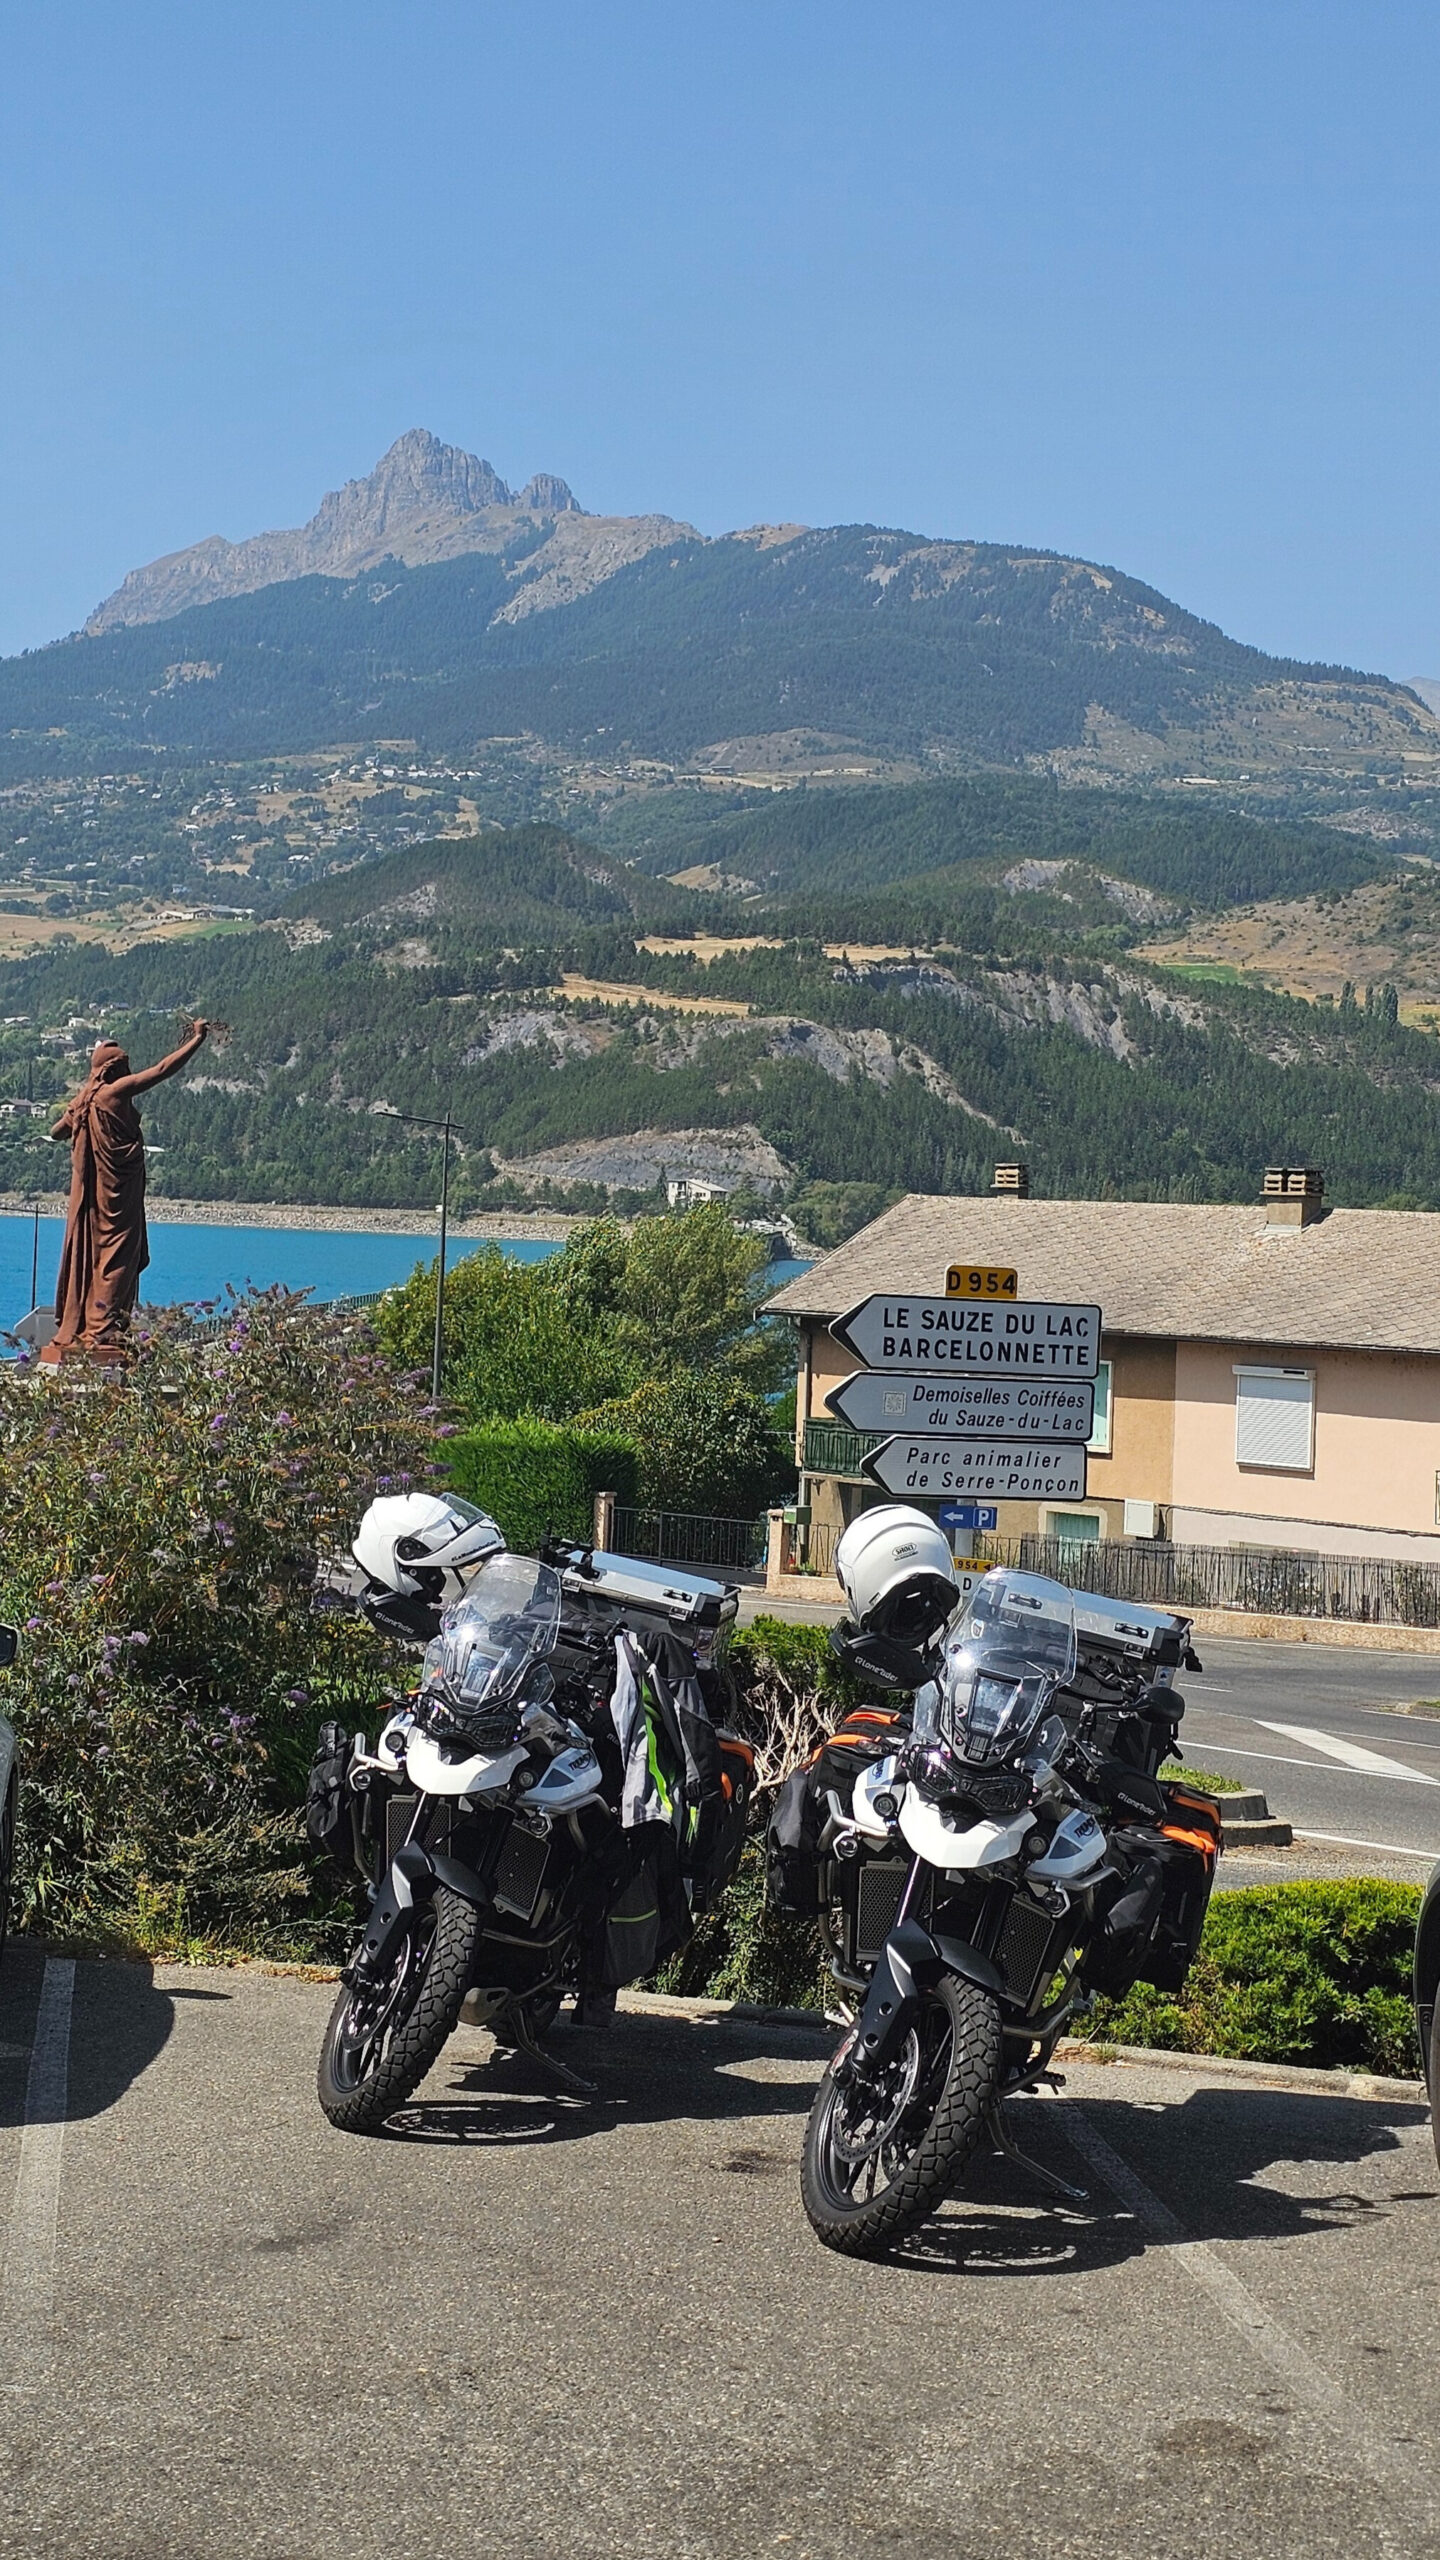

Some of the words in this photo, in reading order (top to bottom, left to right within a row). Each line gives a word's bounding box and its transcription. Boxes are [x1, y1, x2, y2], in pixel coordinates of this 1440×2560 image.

[883, 1307, 910, 1329] LE
[921, 1309, 993, 1333] SAUZE
[1005, 1314, 1035, 1335] DU
[1046, 1315, 1089, 1338] LAC
[883, 1336, 1089, 1366] BARCELONNETTE
[912, 1385, 1010, 1405] Demoiselles
[1017, 1389, 1085, 1409] Coiffées
[928, 1409, 948, 1426] du
[906, 1447, 951, 1466] Parc
[963, 1450, 1062, 1469] animalier
[906, 1471, 929, 1488] de
[941, 1472, 1080, 1493] Serre-Ponçon
[978, 1509, 990, 1526] P
[957, 1560, 978, 1571] 954
